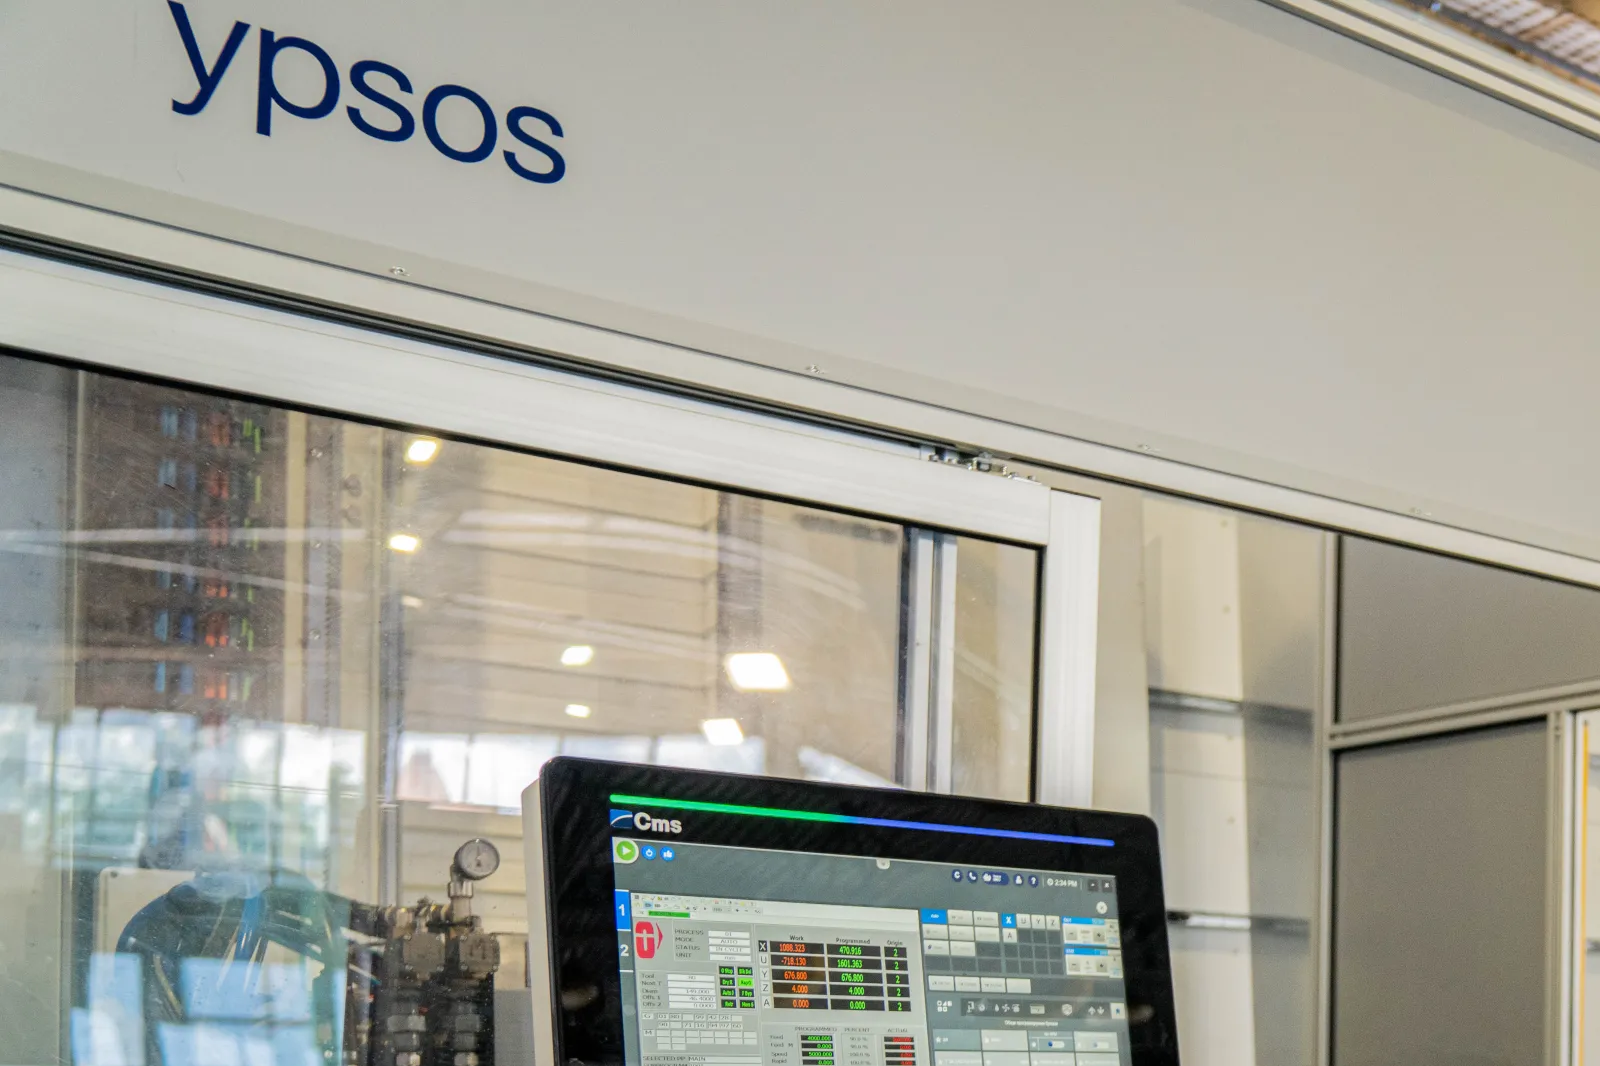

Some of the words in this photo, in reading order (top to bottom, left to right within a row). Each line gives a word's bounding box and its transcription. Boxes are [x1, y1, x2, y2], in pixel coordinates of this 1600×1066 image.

[166, 0, 566, 184] ypsos
[634, 812, 682, 834] Cms
[619, 904, 625, 916] 1
[835, 937, 871, 945] Programmed
[620, 944, 629, 956] 2
[759, 942, 767, 951] X
[839, 945, 862, 955] 470.916
[783, 971, 808, 980] 676.800
[841, 973, 864, 983] 676.800
[791, 984, 809, 994] 4.000
[848, 986, 865, 996] 4.000
[792, 999, 810, 1009] 0.000
[849, 1001, 866, 1010] 0.000
